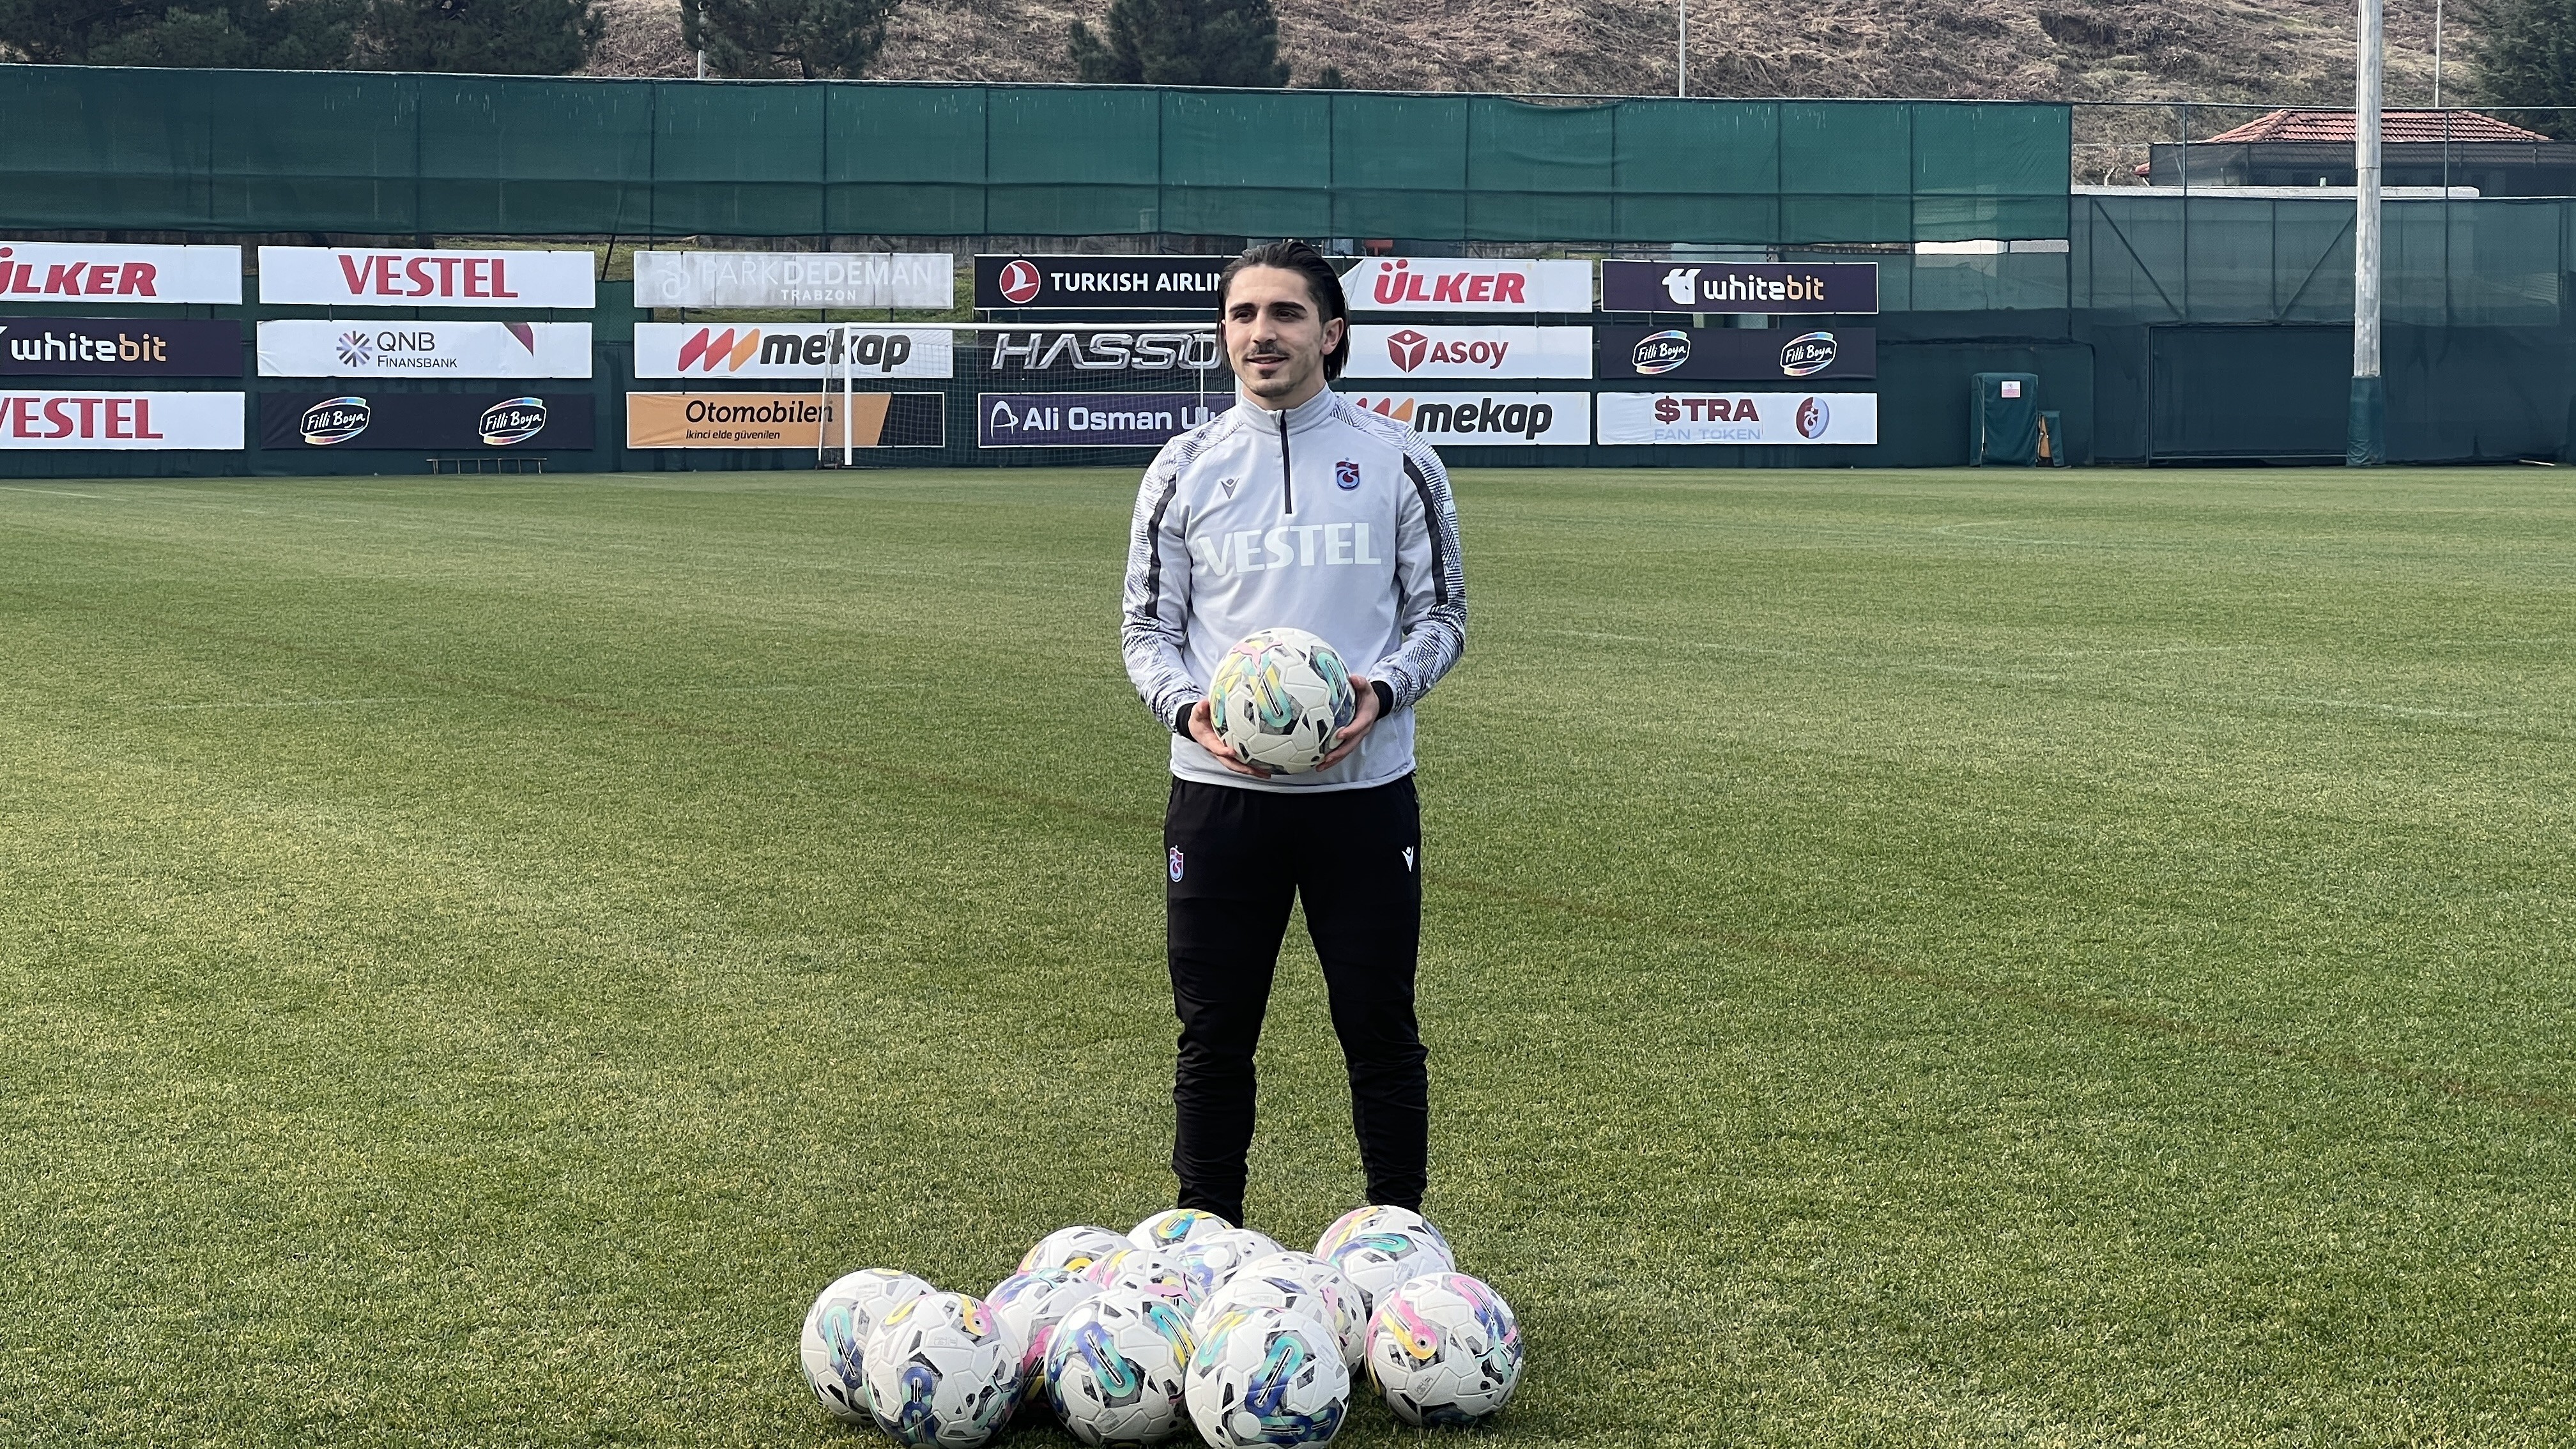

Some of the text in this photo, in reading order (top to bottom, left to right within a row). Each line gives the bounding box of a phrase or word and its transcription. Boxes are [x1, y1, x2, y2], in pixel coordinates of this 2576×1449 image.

[338, 255, 518, 298] VESTEL
[1051, 273, 1148, 291] TURKISH
[1374, 259, 1526, 304] ÜLKER
[781, 289, 856, 301] TRABZON
[1703, 275, 1824, 300] whitebit
[11, 332, 166, 361] whitebit
[377, 332, 435, 352] QNB
[760, 328, 910, 372] mekap
[1638, 343, 1686, 361] Filli Boya
[378, 355, 457, 369] FINANSBANK
[1785, 345, 1832, 363] Filli Boya
[1023, 407, 1059, 431] Ali
[1068, 407, 1172, 431] Osman
[1414, 398, 1552, 440] mekap
[1654, 396, 1759, 424] $TRA
[307, 411, 366, 431] Filli Boya
[486, 411, 542, 431] Filli Boya
[712, 430, 732, 439] elde
[734, 430, 780, 441] güvenilen
[1654, 429, 1761, 440] FAN TOKEN
[1199, 523, 1381, 576] VESTEL
